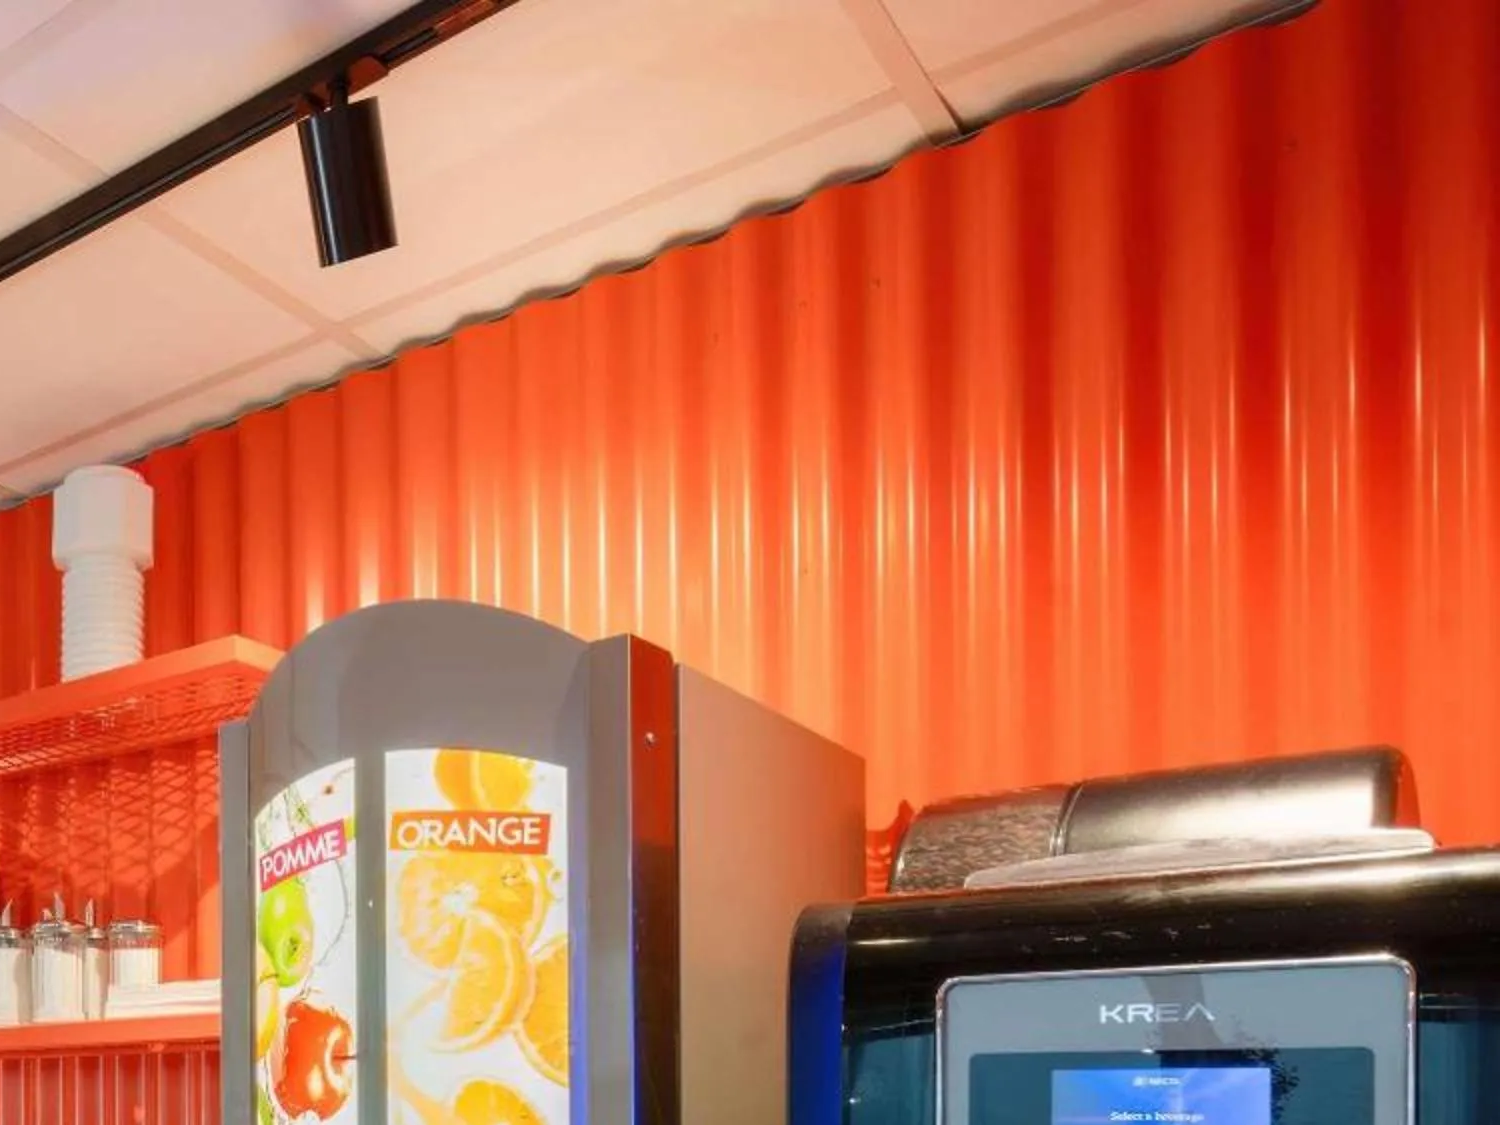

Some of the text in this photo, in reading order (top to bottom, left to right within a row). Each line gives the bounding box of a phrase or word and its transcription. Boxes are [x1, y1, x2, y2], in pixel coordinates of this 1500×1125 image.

[397, 816, 542, 849] ORANGE
[260, 828, 341, 883] POMME
[1099, 1003, 1215, 1025] KREA
